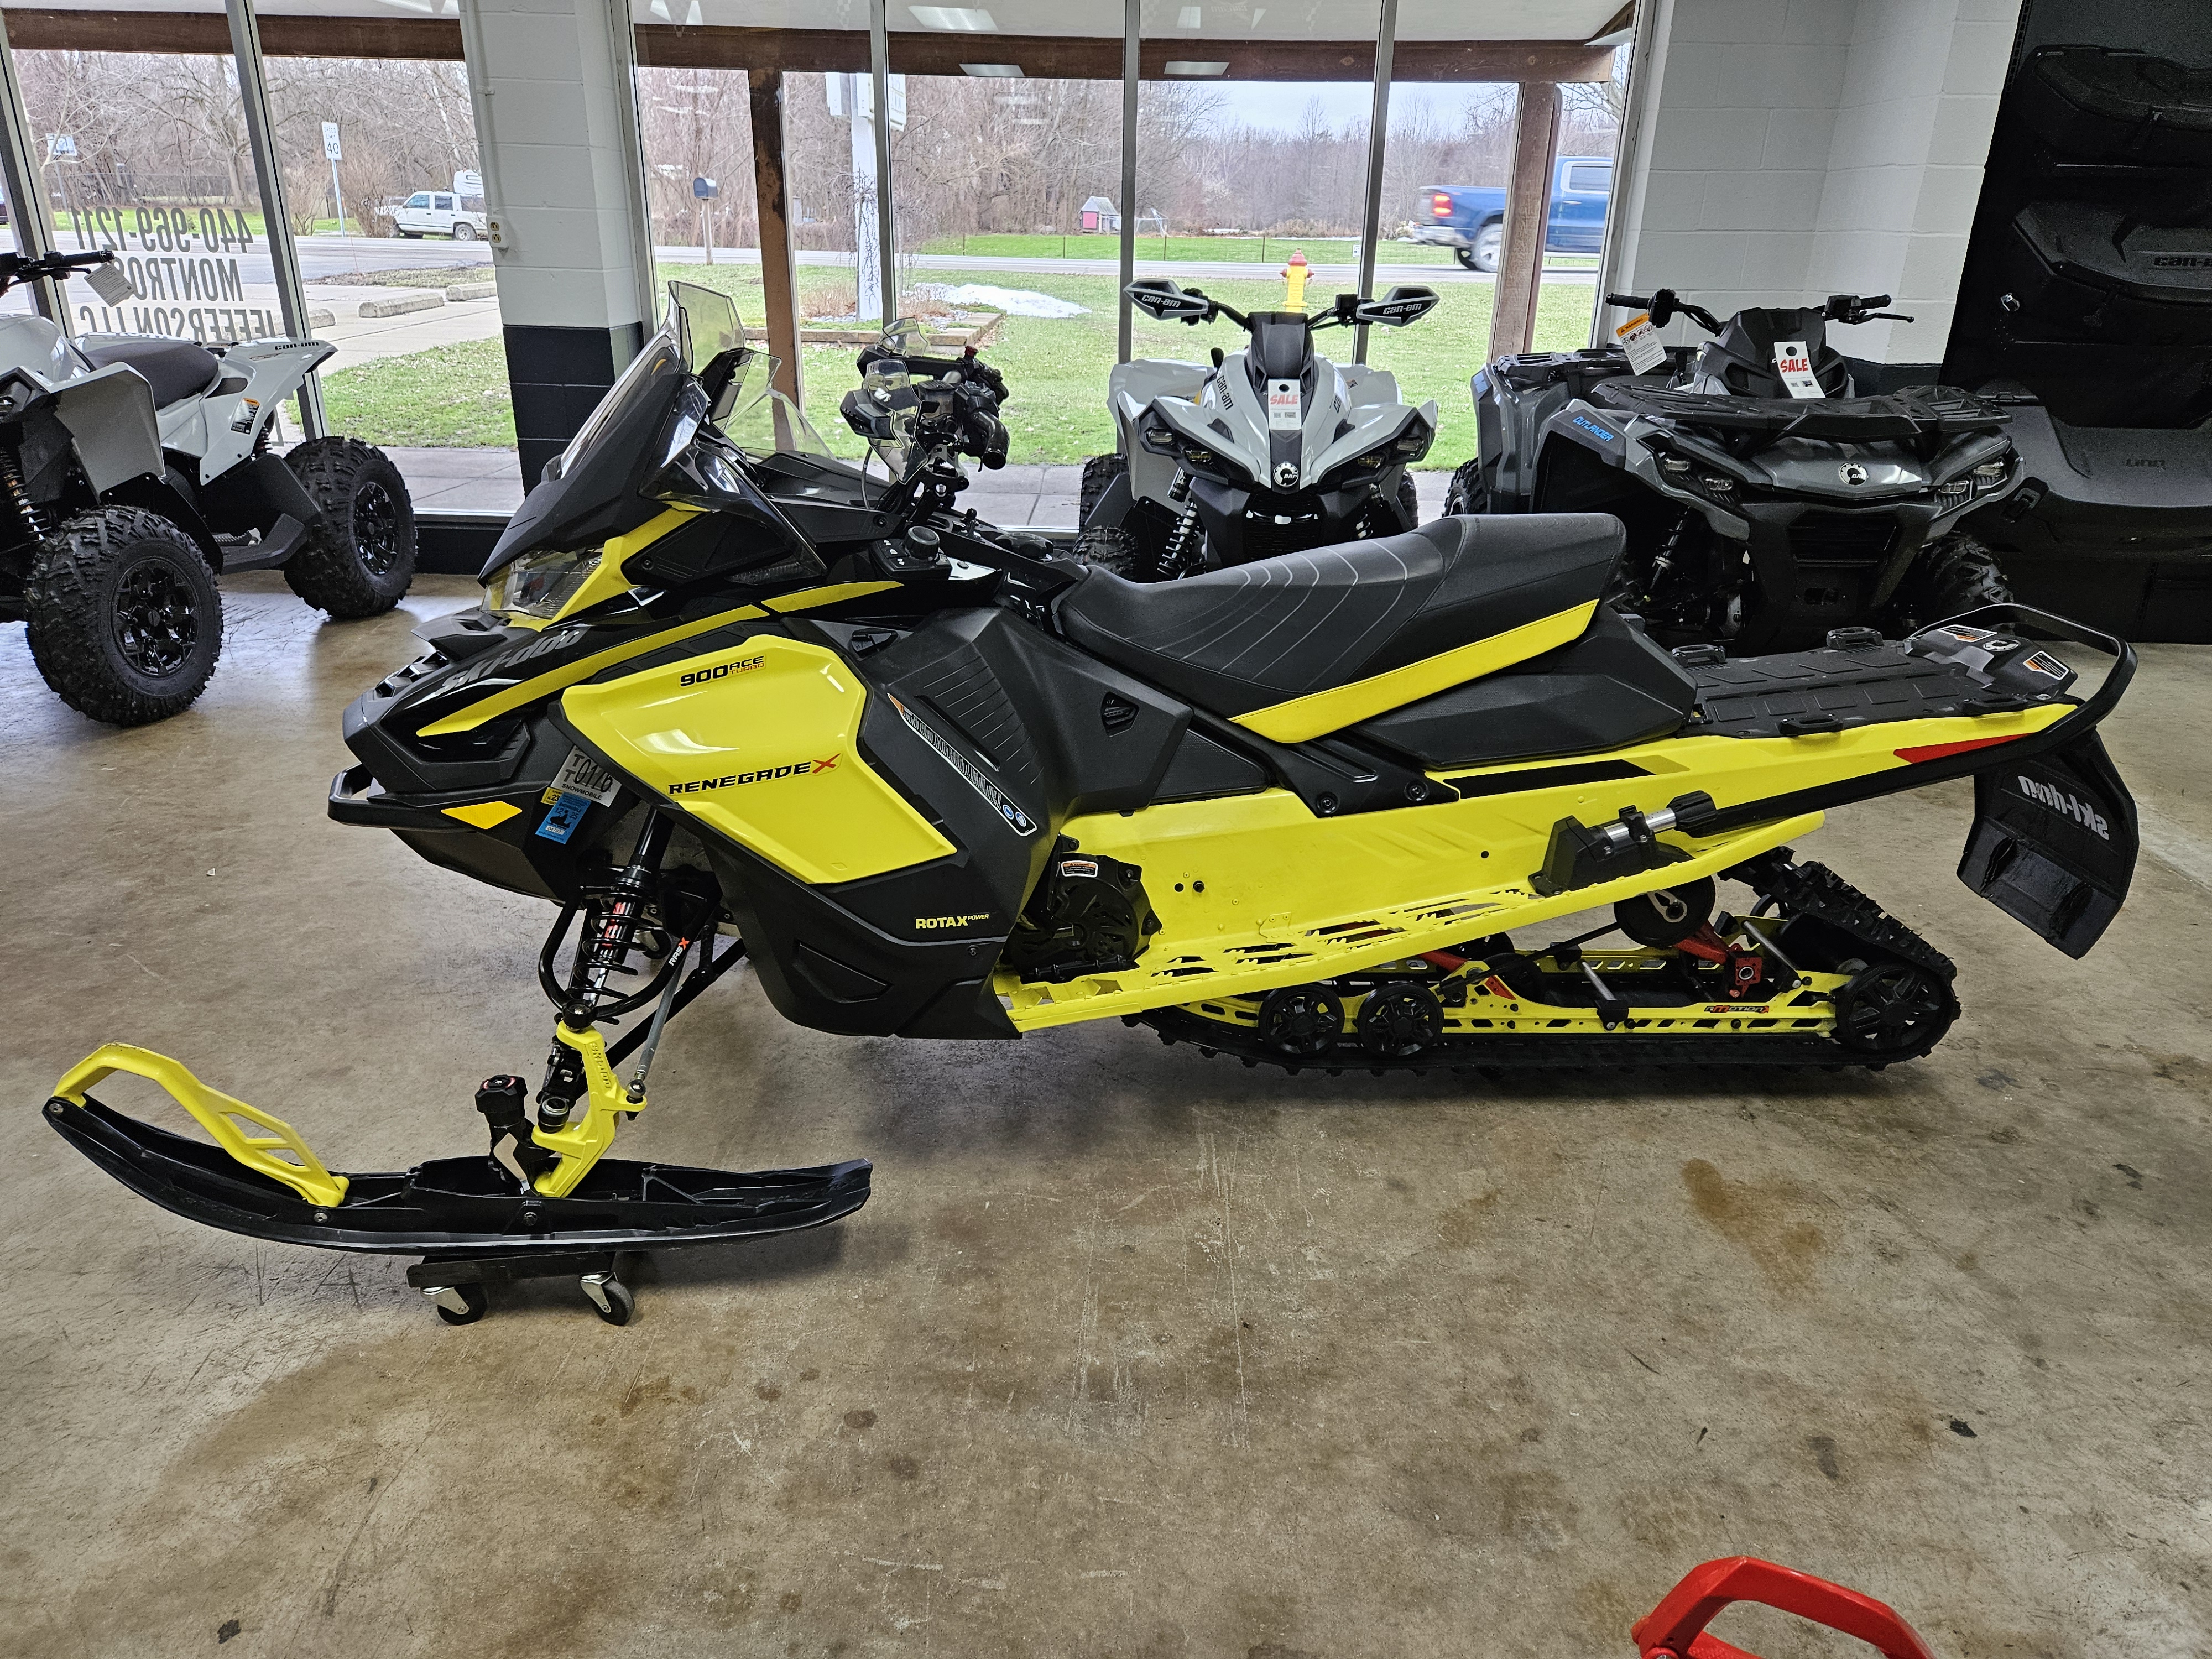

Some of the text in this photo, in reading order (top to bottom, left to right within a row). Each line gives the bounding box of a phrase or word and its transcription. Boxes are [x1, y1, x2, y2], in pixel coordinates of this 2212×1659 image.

[327, 142, 338, 154] 40
[1141, 294, 1181, 308] can-am
[1383, 303, 1422, 315] can-am
[275, 341, 320, 351] can-am
[1780, 358, 1809, 373] SALE
[1217, 375, 1234, 411] can-am
[1269, 394, 1299, 405] SALE
[1572, 416, 1614, 442] OUTLANDER
[680, 655, 764, 687] 900 ACE
[729, 662, 764, 675] TURBO
[561, 783, 603, 800] SNOWMOBILE
[915, 915, 968, 930] ROTAX
